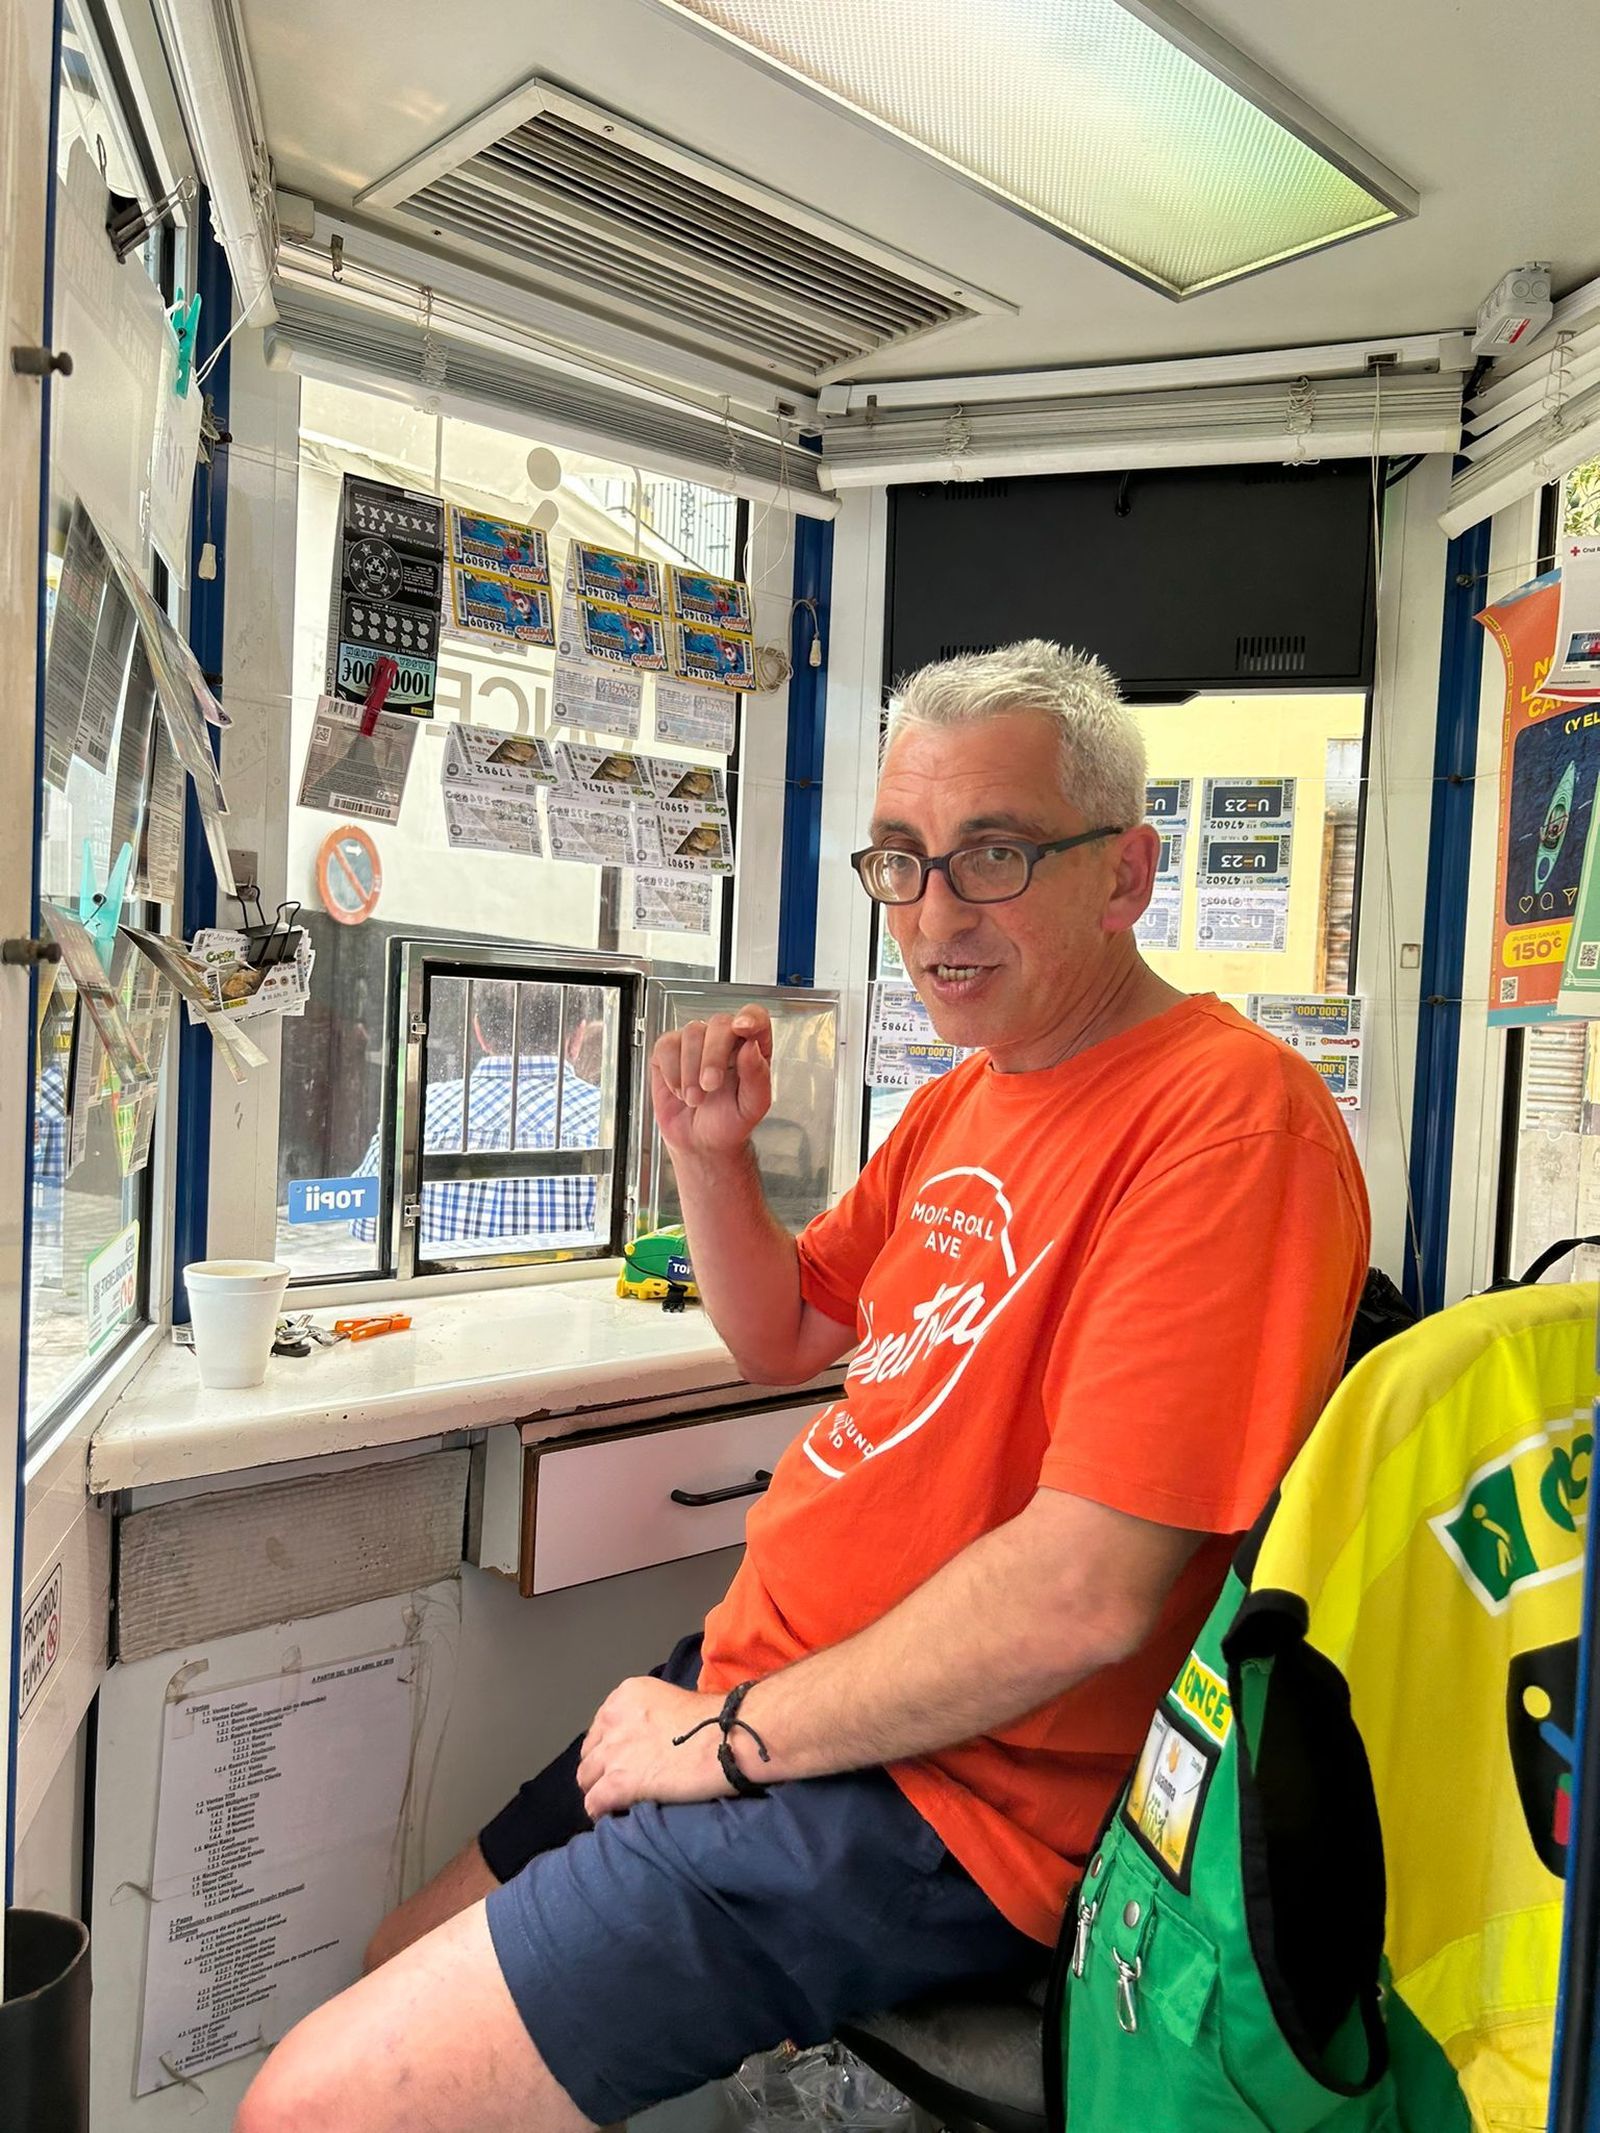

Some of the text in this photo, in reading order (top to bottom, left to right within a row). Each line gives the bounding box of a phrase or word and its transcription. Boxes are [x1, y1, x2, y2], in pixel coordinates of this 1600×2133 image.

[465, 554, 547, 582] Verano 26809
[586, 586, 660, 611] Verano 20146
[682, 609, 750, 630] Verano 20146
[470, 617, 553, 642] Verano 26809
[592, 645, 666, 669] Verano 20146
[687, 667, 754, 687] Verano 20146
[1565, 717, 1582, 734] (Y
[476, 764, 512, 778] 17982
[1210, 820, 1244, 829] 47602
[1206, 876, 1240, 884] 47602
[1512, 930, 1560, 942] PUEDES GANAR
[1512, 937, 1562, 960] 150€
[230, 999, 247, 1007] ONCE
[882, 1022, 913, 1031] 17985
[876, 1075, 908, 1084] 17985
[24, 1579, 58, 1658] PROHIBIDO
[23, 1640, 45, 1703] FUMAR
[317, 1672, 335, 1682] PARTIR
[1184, 1666, 1230, 1729] ONCE
[191, 1704, 210, 1713] Ventas
[211, 1705, 257, 1722] Ventas Especiales
[212, 1700, 247, 1715] Ventas Cupón
[231, 1716, 245, 1724] Bono
[246, 1712, 261, 1721] cupón
[230, 1723, 247, 1733] Cupón
[230, 1729, 250, 1739] Reserva
[251, 1731, 272, 1741] Reserva
[251, 1740, 265, 1749] Venta
[228, 1754, 267, 1769] Reserva Cliente
[248, 1763, 262, 1771] Venta
[247, 1772, 281, 1786] Nuevo Cliente
[205, 1796, 223, 1805] Ventas
[206, 1802, 224, 1812] Ventas
[219, 1836, 235, 1845] Rasca
[221, 1839, 246, 1851] Confirmar
[220, 1849, 238, 1859] Activar
[221, 1847, 264, 1866] Consultar Estado
[218, 1871, 233, 1881] ONCE
[175, 1915, 192, 1925] Pagos
[227, 1915, 250, 1928] actividad
[215, 1929, 235, 1940] Informe
[244, 1917, 266, 1930] actividad
[215, 1936, 234, 1947] Informe
[243, 1924, 265, 1937] actividad
[225, 1935, 256, 1951] operaciones
[213, 1950, 233, 1962] Informe
[213, 1957, 233, 1969] Informe
[241, 1949, 256, 1960] pagos
[234, 1958, 249, 1969] Pagos
[233, 1966, 248, 1977] Pagos
[212, 1979, 231, 1991] Informe
[211, 1986, 230, 1998] Informe
[222, 2029, 237, 2041] ONCE
